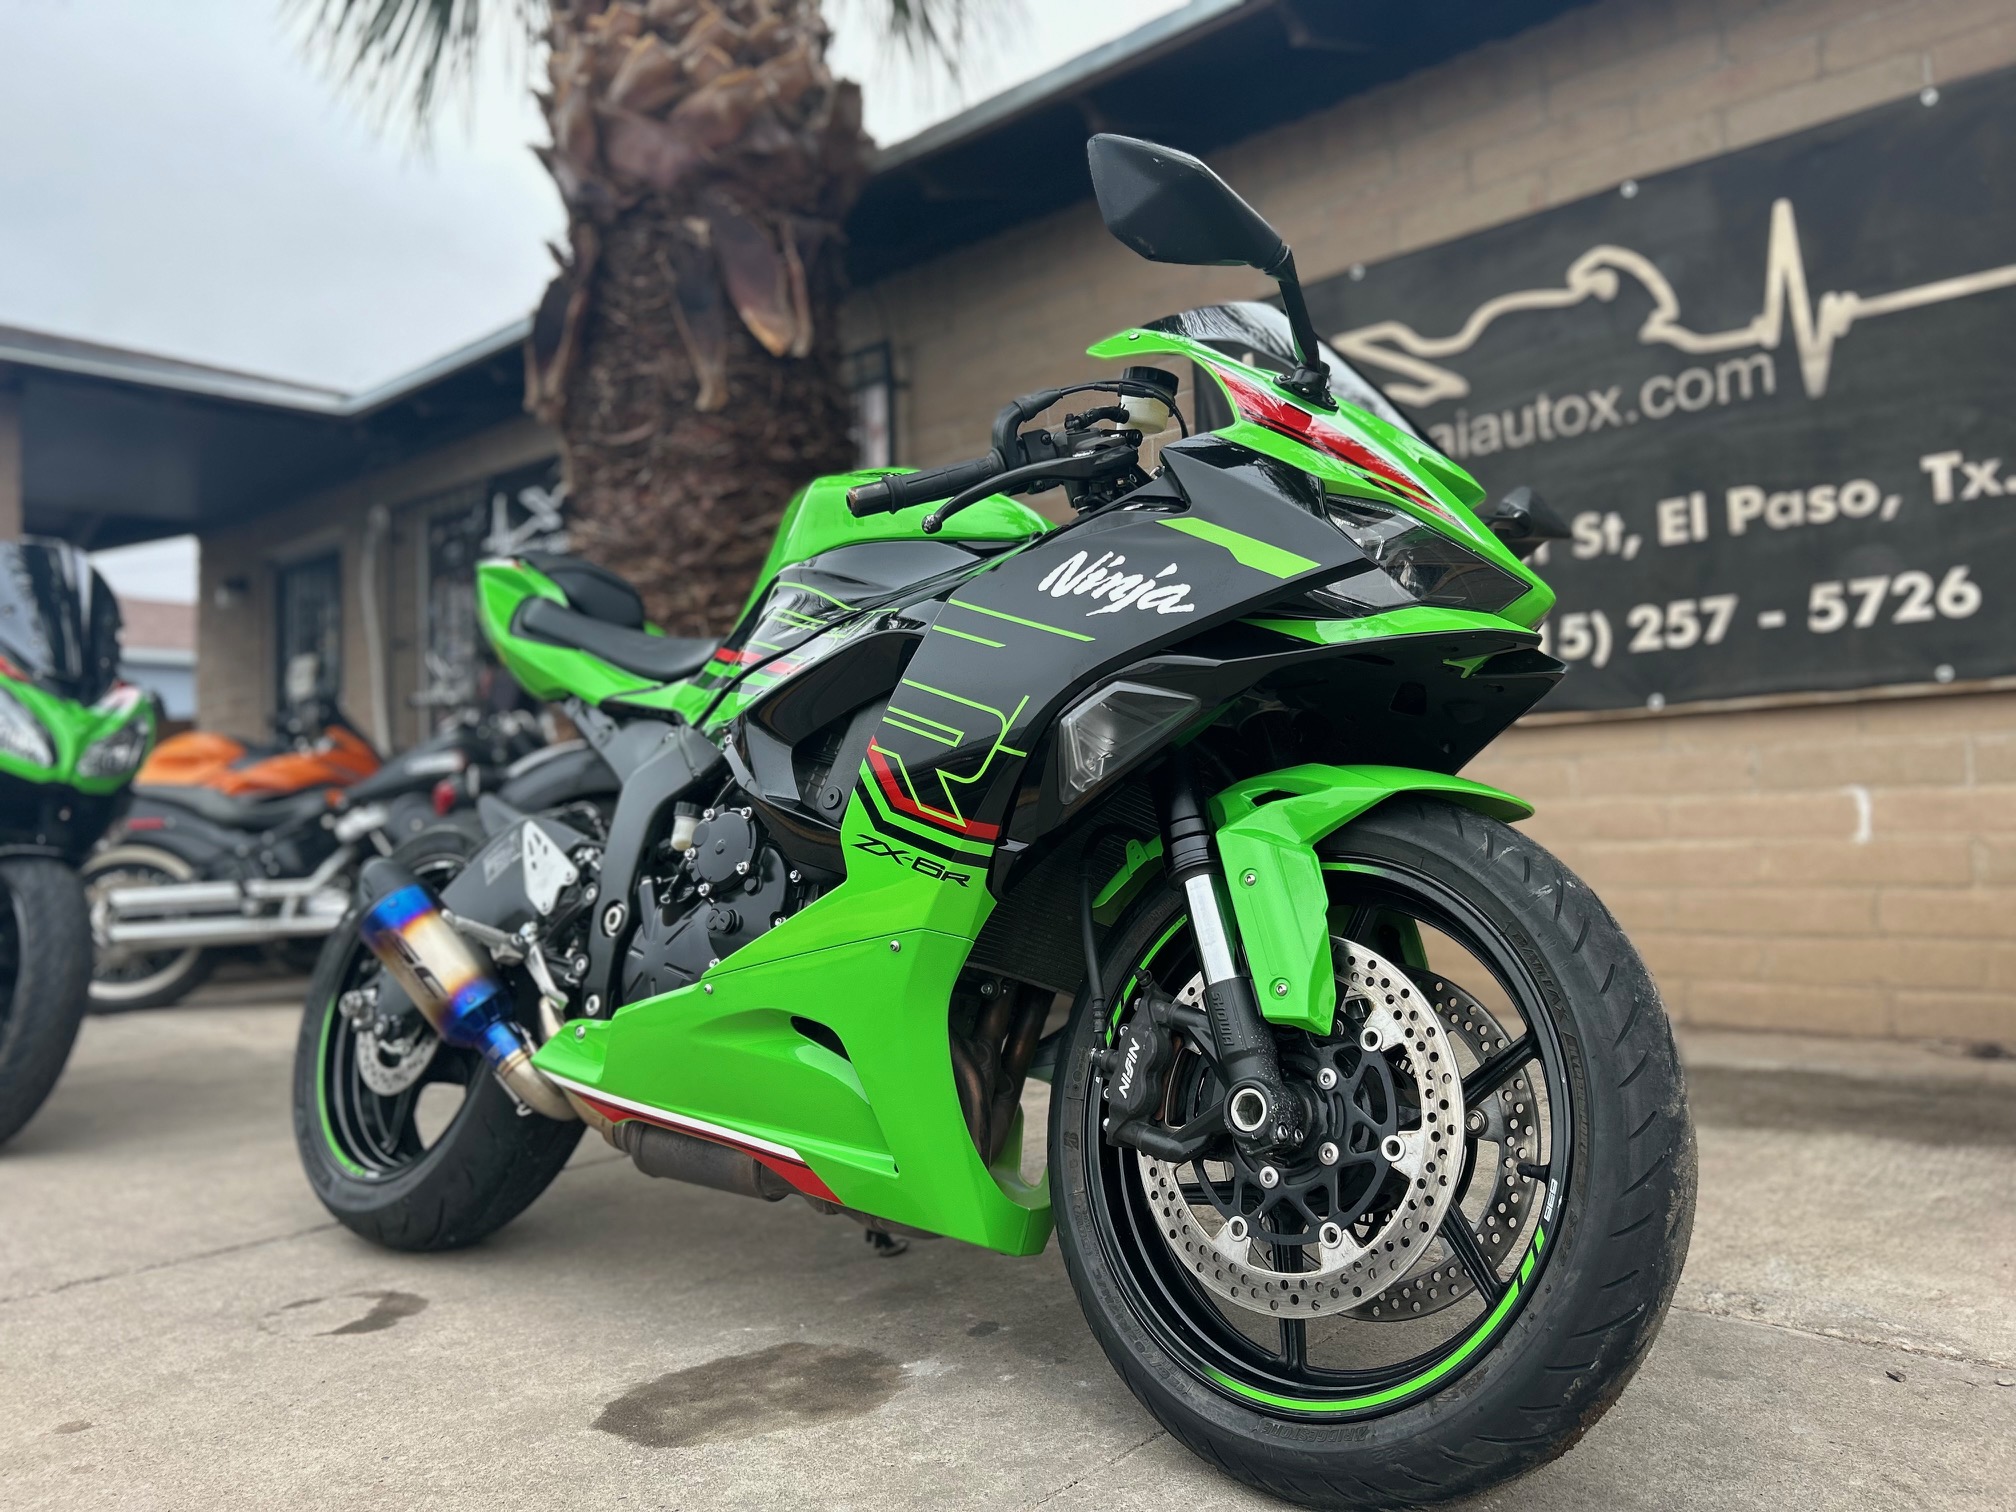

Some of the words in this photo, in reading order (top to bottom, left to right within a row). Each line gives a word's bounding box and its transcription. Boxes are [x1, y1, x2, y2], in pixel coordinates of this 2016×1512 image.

[1571, 511, 1642, 560] St,
[1656, 491, 1708, 546] El
[1726, 478, 1901, 536] Paso,
[1919, 450, 2016, 504] Tx.
[1038, 550, 1195, 617] Ninja
[1627, 593, 1738, 653] 257
[1807, 566, 1982, 633] 5726
[851, 834, 970, 888] ZX-6R
[1211, 991, 1235, 1047] SHOWA
[1118, 1037, 1140, 1099] NISSIN
[1262, 1421, 1370, 1443] BRIDGESTONE
